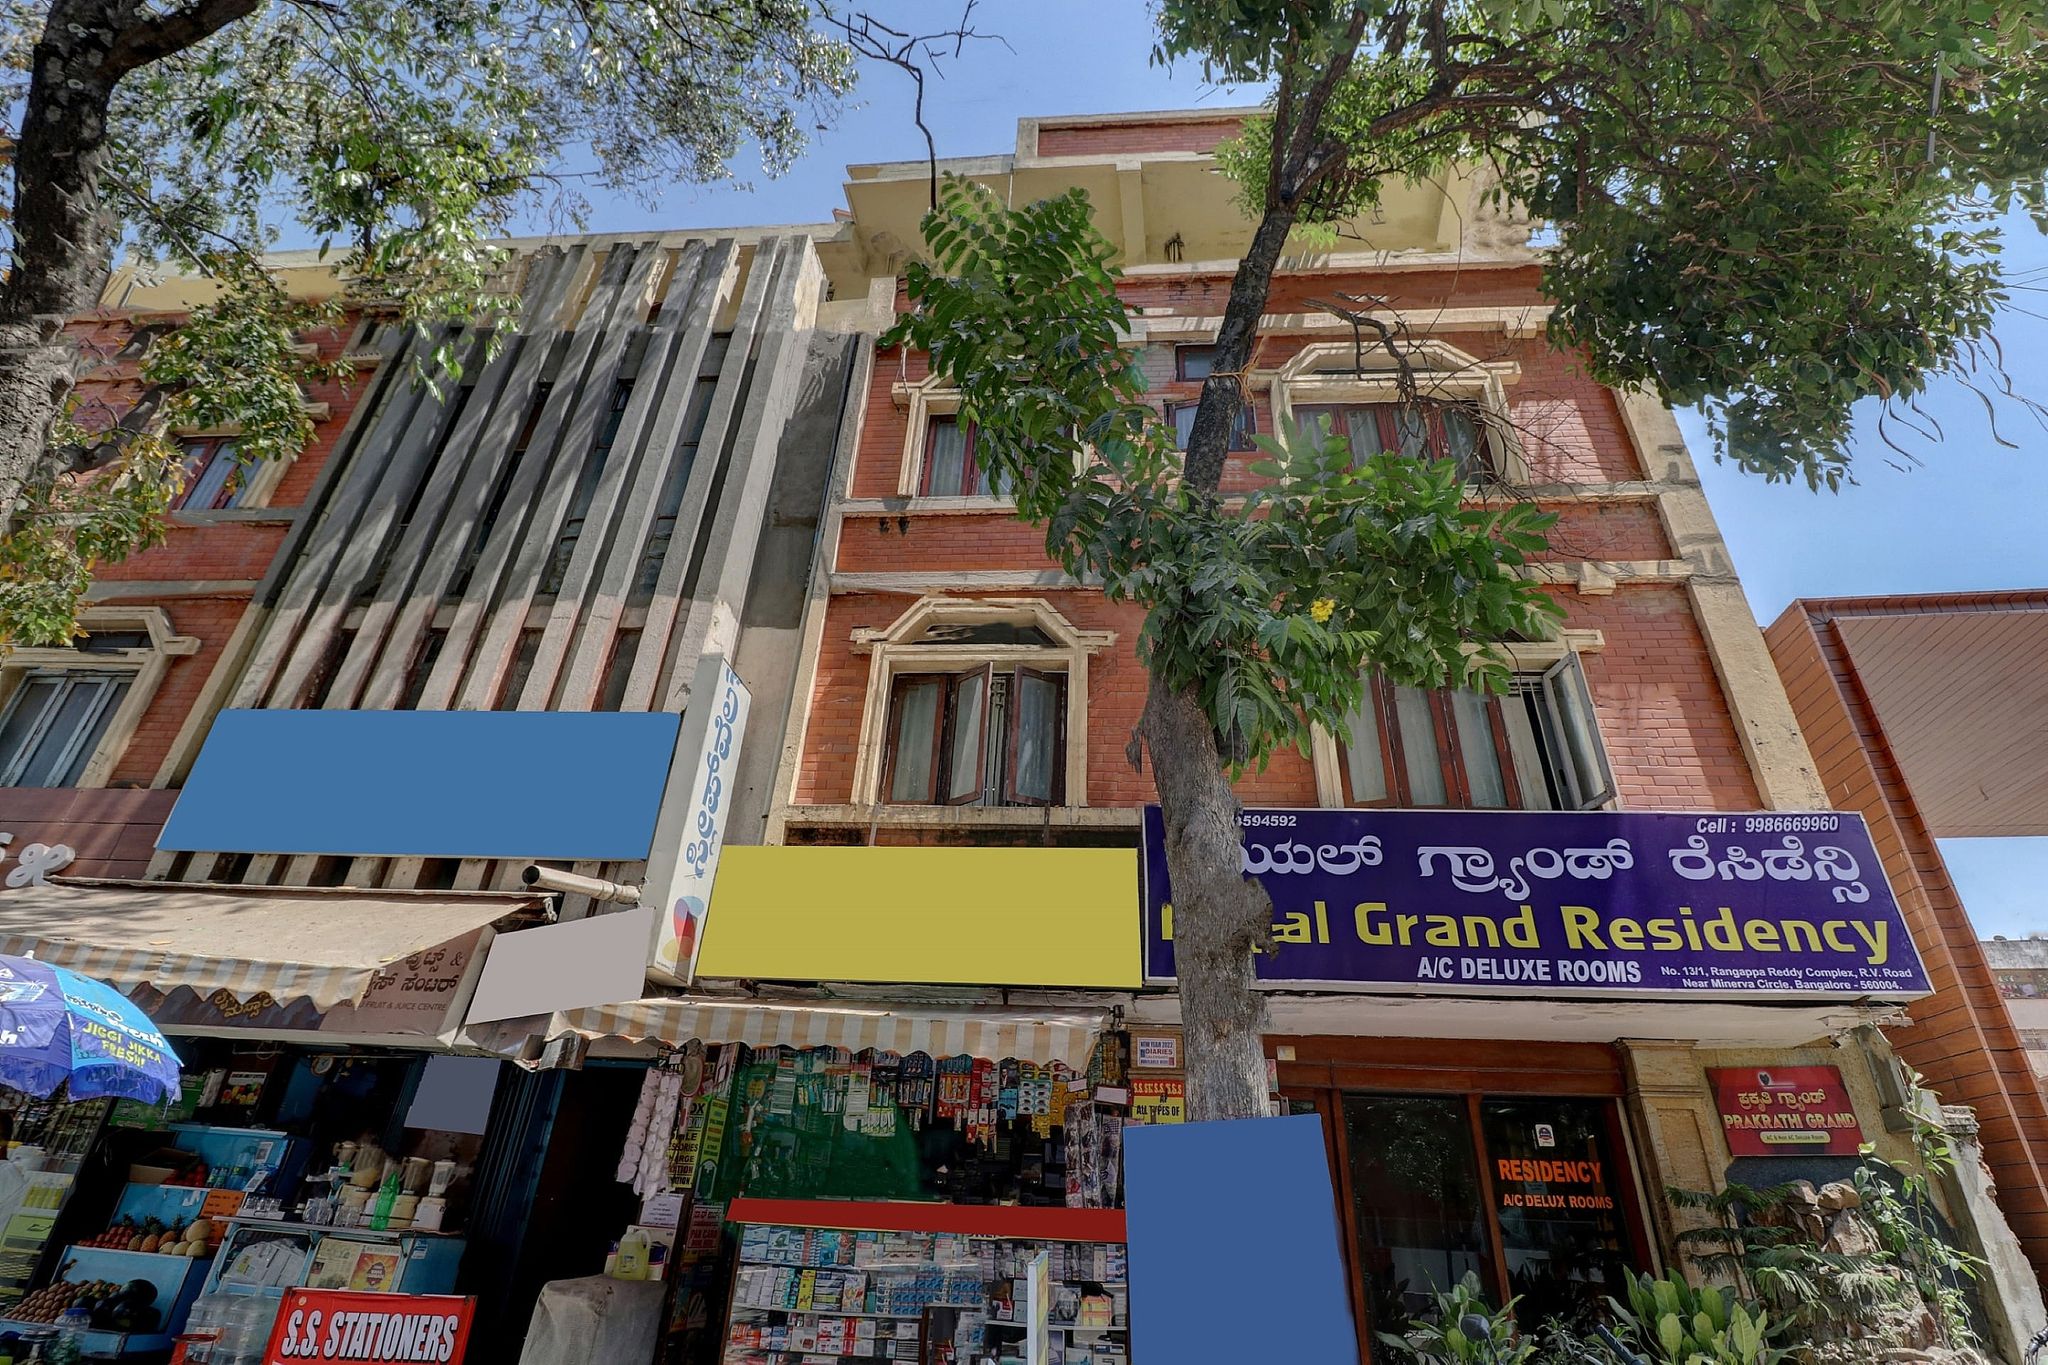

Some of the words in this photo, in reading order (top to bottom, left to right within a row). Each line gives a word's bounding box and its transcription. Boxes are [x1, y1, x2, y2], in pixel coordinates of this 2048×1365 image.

[1697, 818, 1727, 833] Cell
[1745, 816, 1839, 833] 9986669960
[1241, 835, 1383, 875] ಯಲ್
[1417, 838, 1634, 901] ಗ್ರ್ಯಾಂಡ್
[1668, 835, 1870, 903] ರೆಸಿಡೆನ್ಸಿ
[1354, 902, 1540, 949] Grand
[1560, 906, 1888, 966] Residency
[1417, 956, 1454, 979] A/C
[1461, 957, 1552, 981] DELUXE
[1558, 959, 1642, 983] ROOMS
[1661, 966, 1681, 976] No.
[1682, 966, 1709, 978] 13/1,
[1710, 966, 1766, 980] Rangappa
[1768, 967, 1802, 980] Reddy
[1805, 968, 1857, 980] Complex,
[1859, 968, 1881, 977] R.V.
[1884, 968, 1912, 978] Road
[1683, 979, 1709, 989] Near
[1712, 979, 1755, 989] Minerva
[1796, 979, 1851, 991] Bangalore
[1861, 980, 1903, 990] 560004.
[418, 1002, 448, 1011] CENTRE
[82, 1022, 122, 1043] JIGGI
[127, 1041, 161, 1064] JIKKA
[101, 1040, 146, 1068] FRESH!
[1136, 1105, 1147, 1115] ALL
[1149, 1105, 1170, 1116] TYPES
[1171, 1106, 1180, 1116] OF
[1723, 1113, 1804, 1129] PRAKRATHI
[1805, 1112, 1857, 1129] GRAND
[1498, 1159, 1602, 1184] RESIDENCY
[1503, 1194, 1523, 1207] A/C
[1525, 1195, 1566, 1208] DELUX
[1568, 1196, 1613, 1209] ROOMS
[280, 1309, 322, 1358] S.S.
[323, 1310, 459, 1363] STATIONERS
